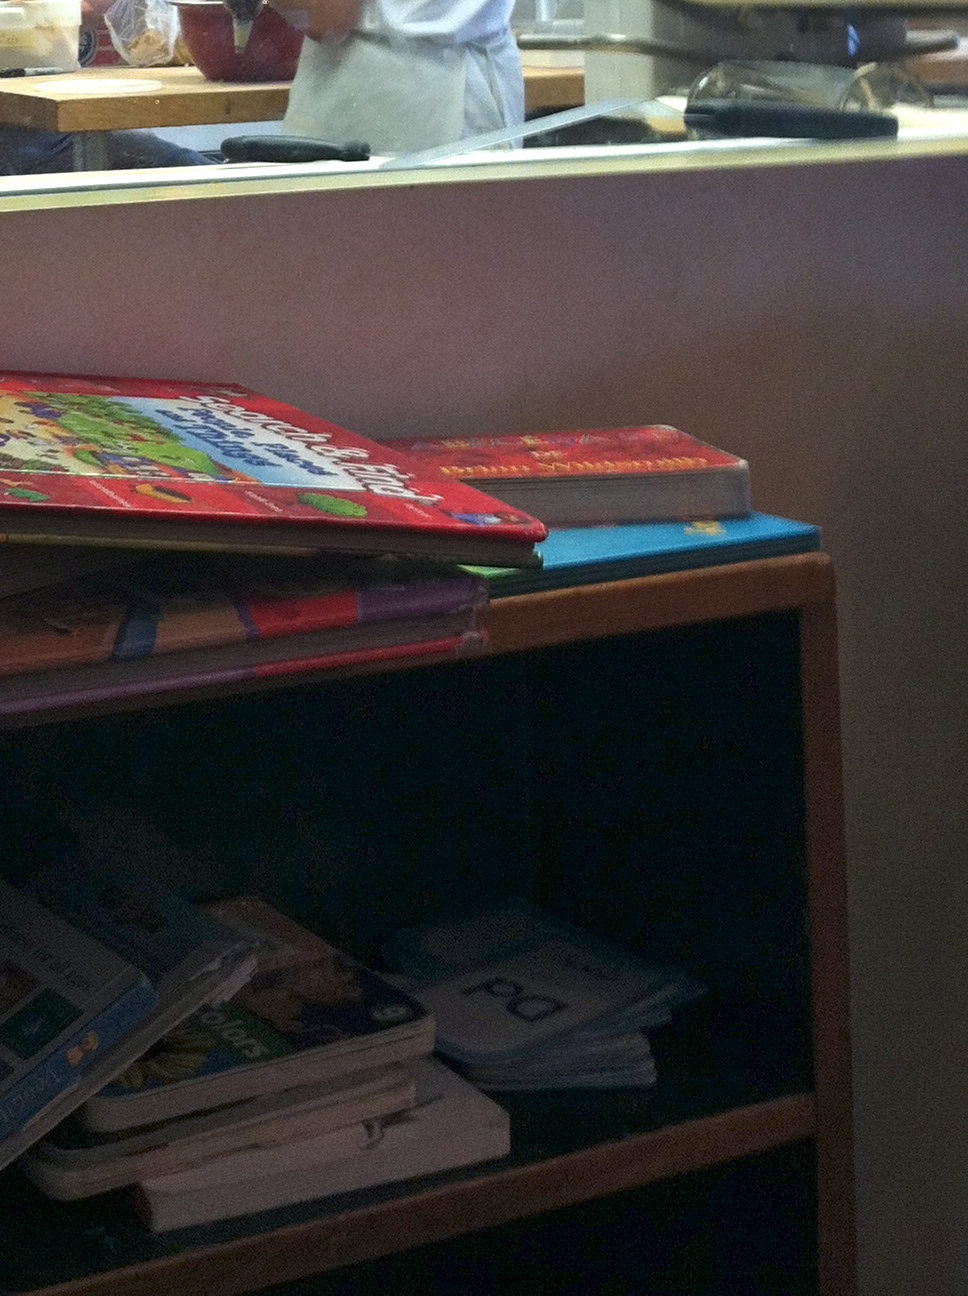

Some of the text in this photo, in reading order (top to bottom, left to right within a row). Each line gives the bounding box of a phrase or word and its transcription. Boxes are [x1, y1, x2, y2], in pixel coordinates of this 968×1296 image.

[178, 395, 332, 445] Search
[173, 423, 283, 467] Things
[305, 441, 370, 462] &
[332, 458, 445, 507] Find
